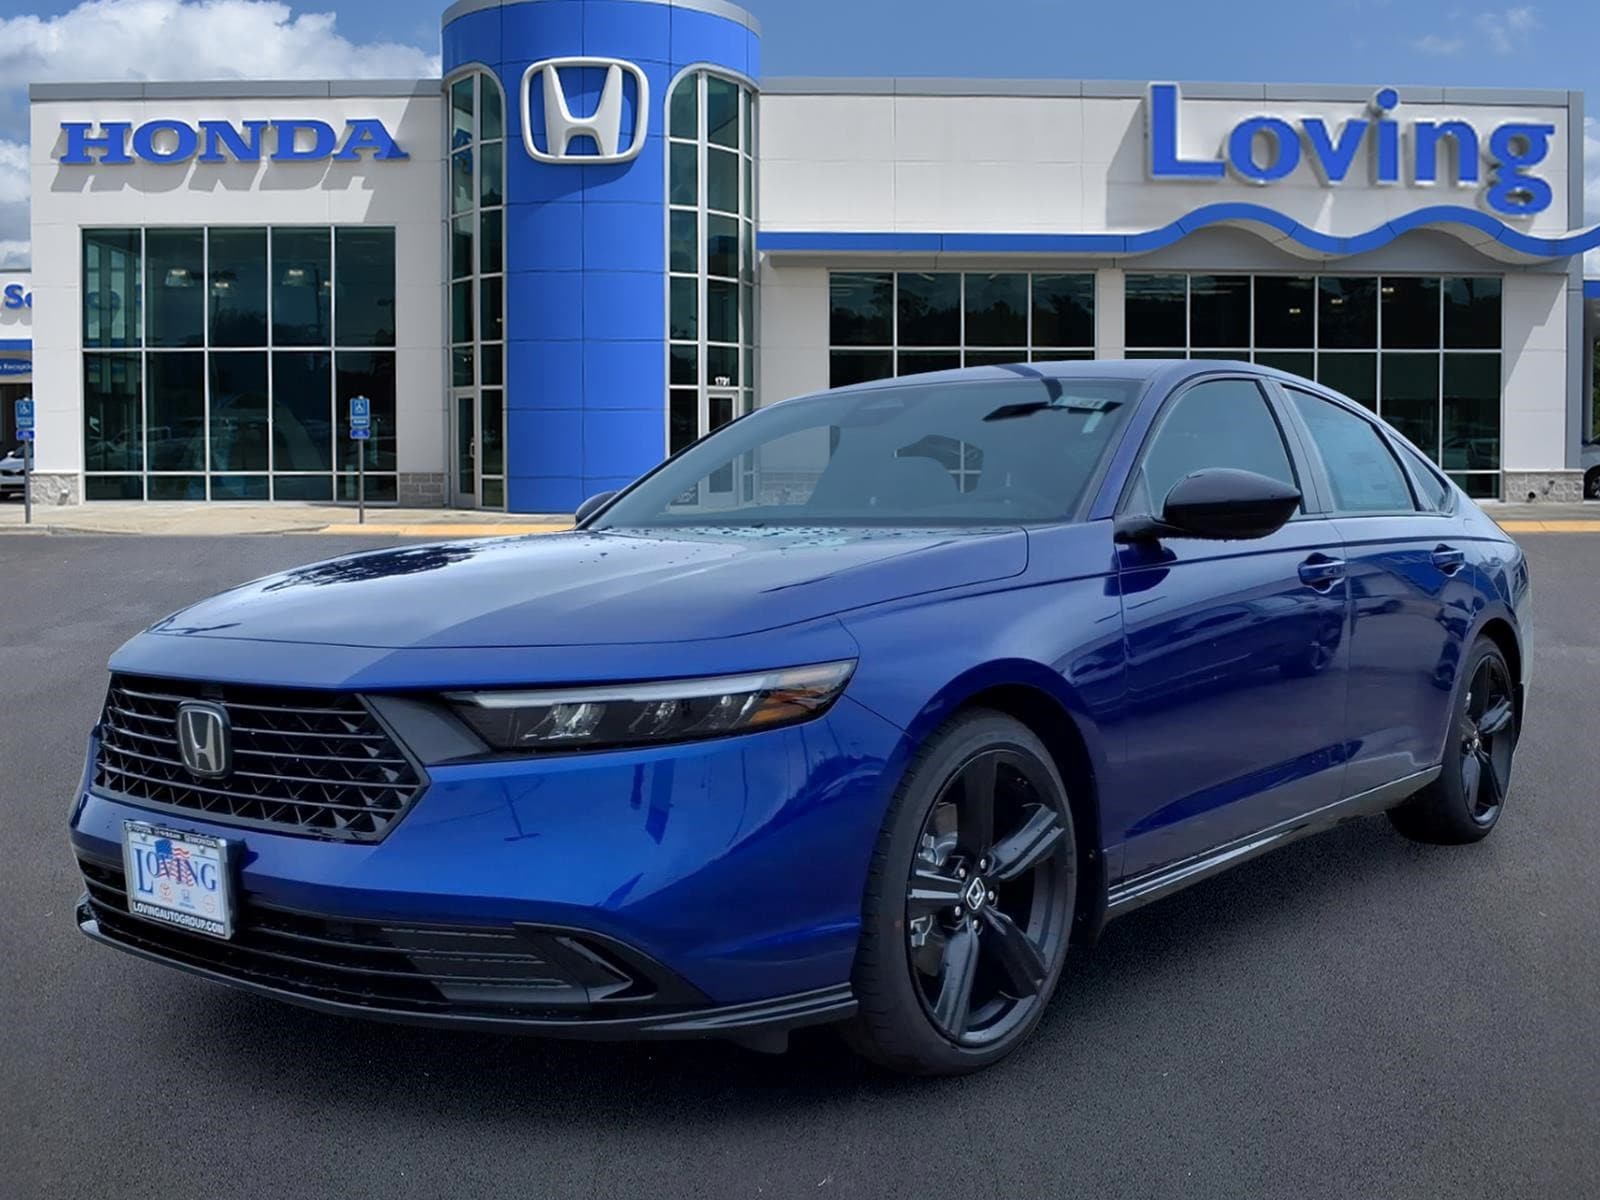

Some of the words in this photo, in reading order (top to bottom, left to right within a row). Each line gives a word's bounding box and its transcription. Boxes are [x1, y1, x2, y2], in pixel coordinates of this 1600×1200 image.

[59, 117, 411, 165] HONDA
[1148, 82, 1556, 216] Loving
[135, 848, 216, 894] LOVING
[133, 901, 225, 935] LOVINGAUTOGROUP.COM
